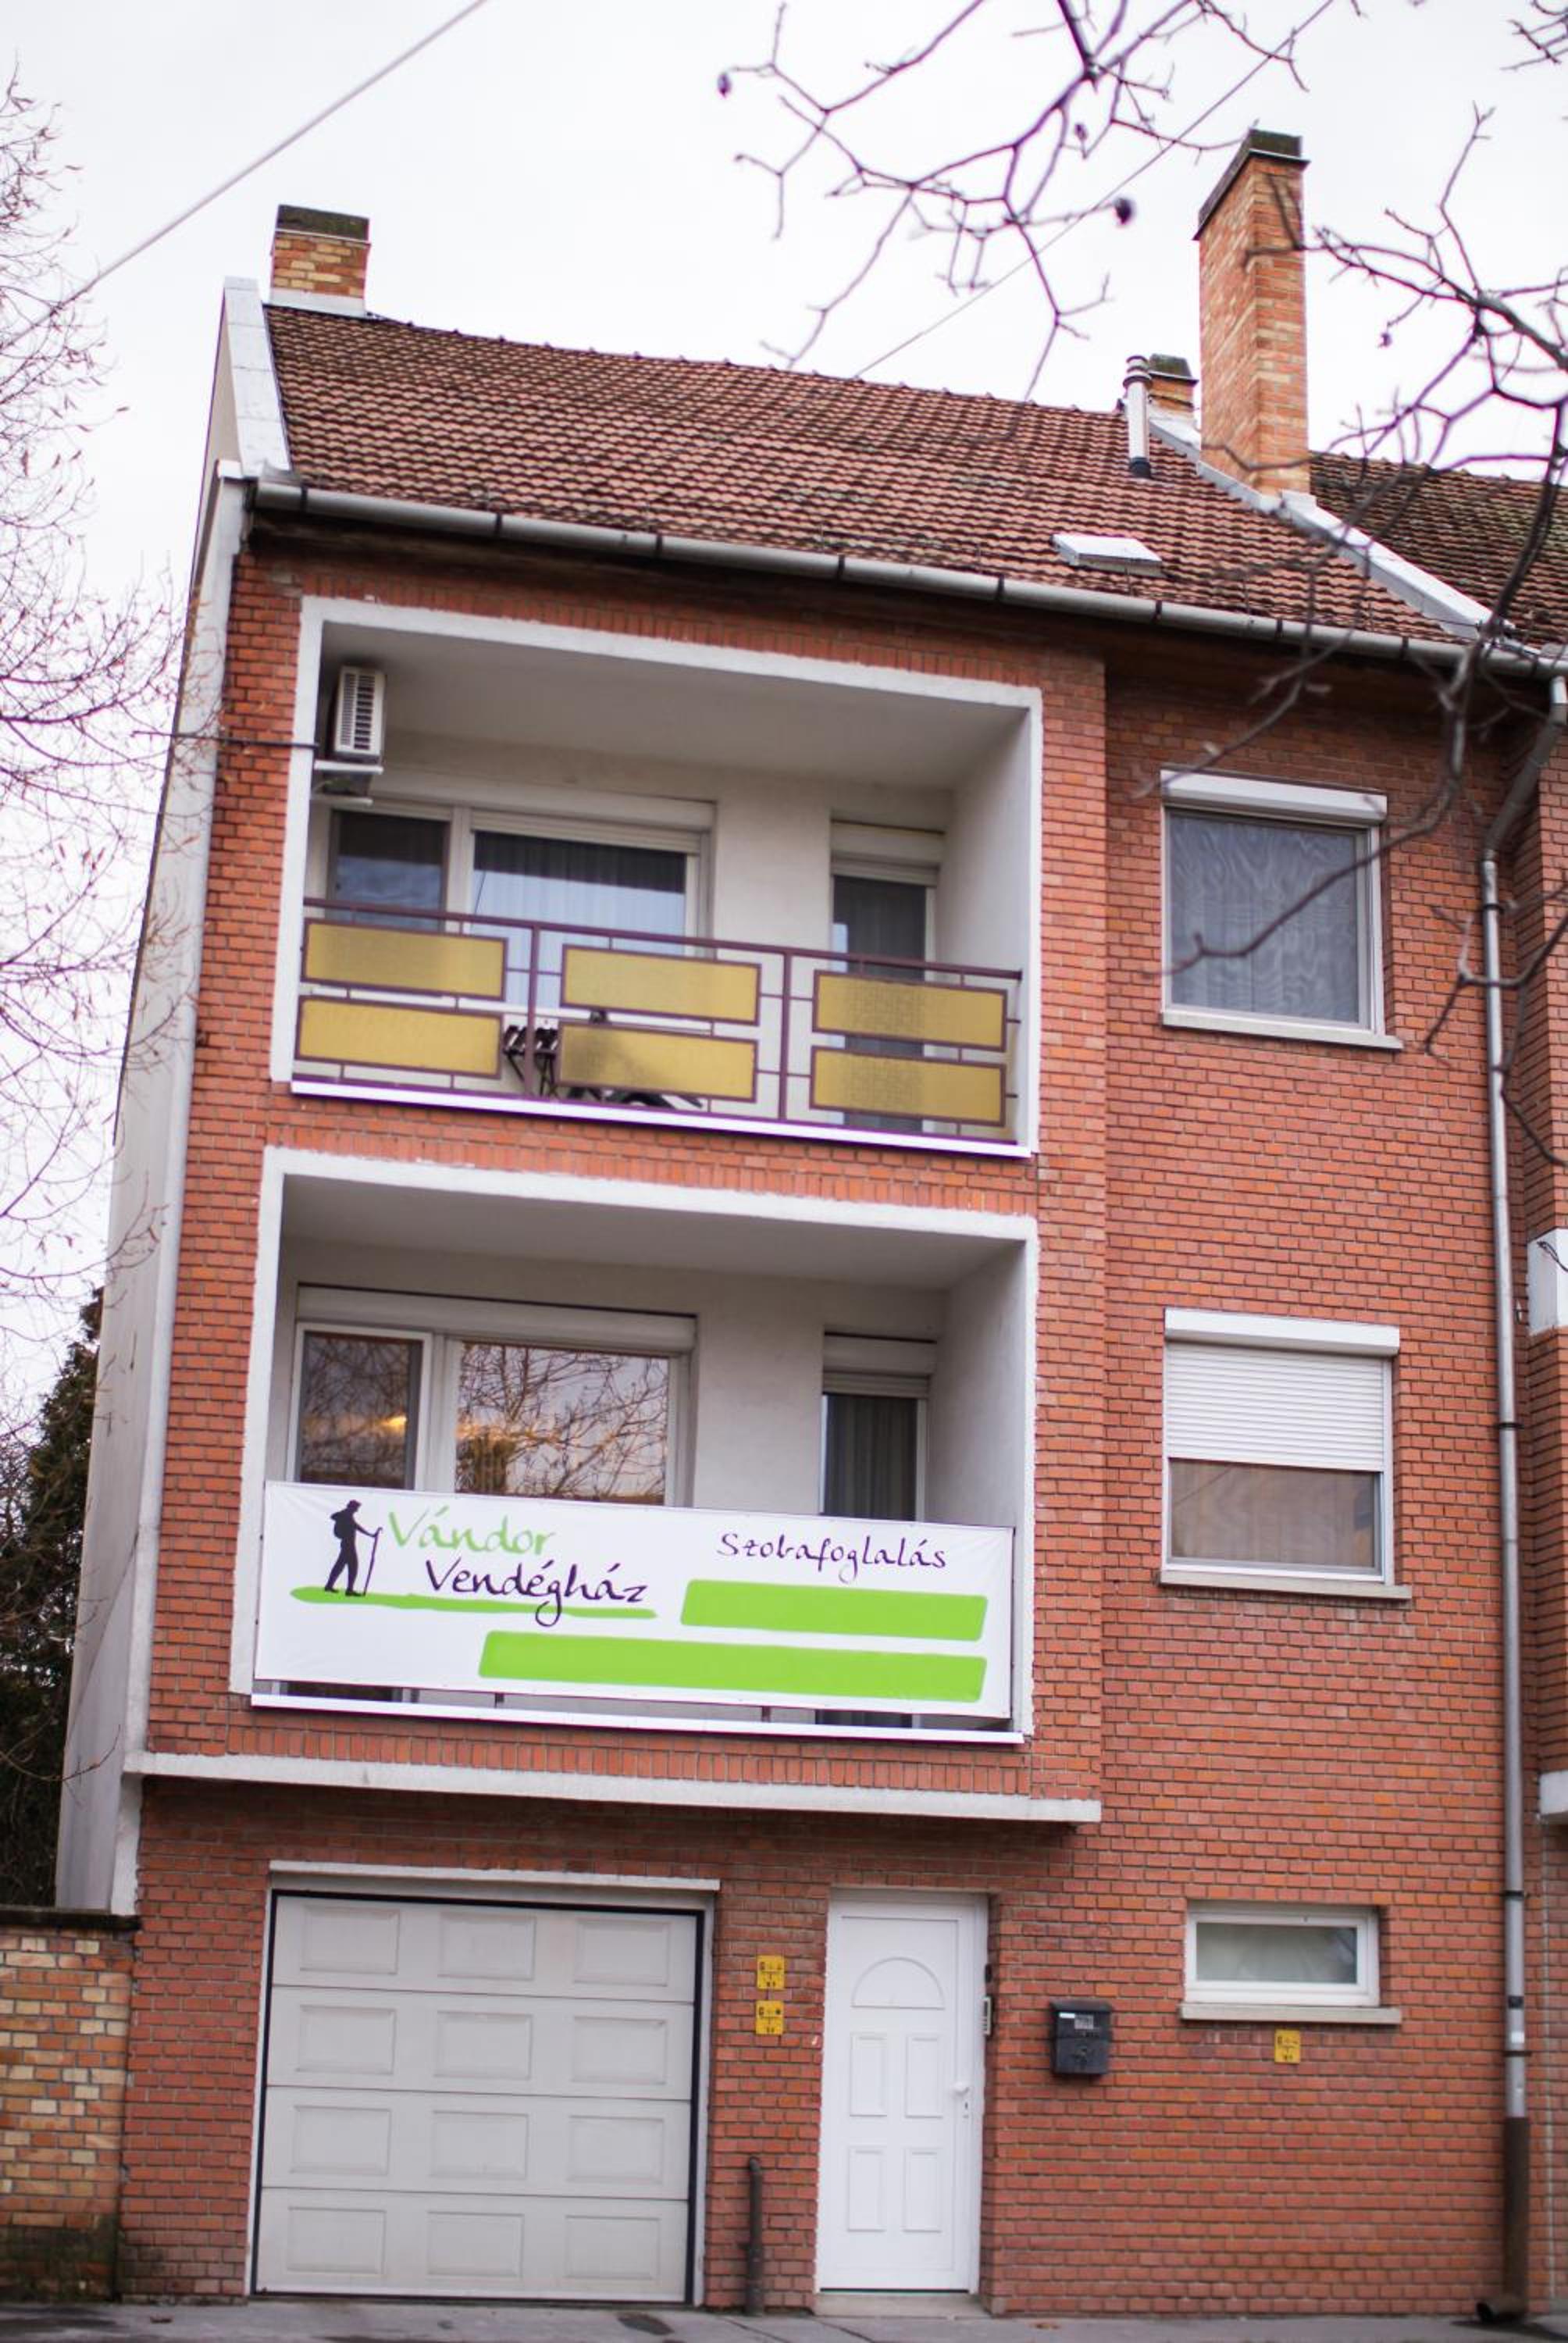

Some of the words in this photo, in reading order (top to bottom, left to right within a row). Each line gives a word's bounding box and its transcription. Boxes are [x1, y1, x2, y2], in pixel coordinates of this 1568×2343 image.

[389, 1507, 556, 1556] Vándor
[718, 1532, 948, 1583] Szobafoglalás
[426, 1559, 649, 1628] Vendégház
